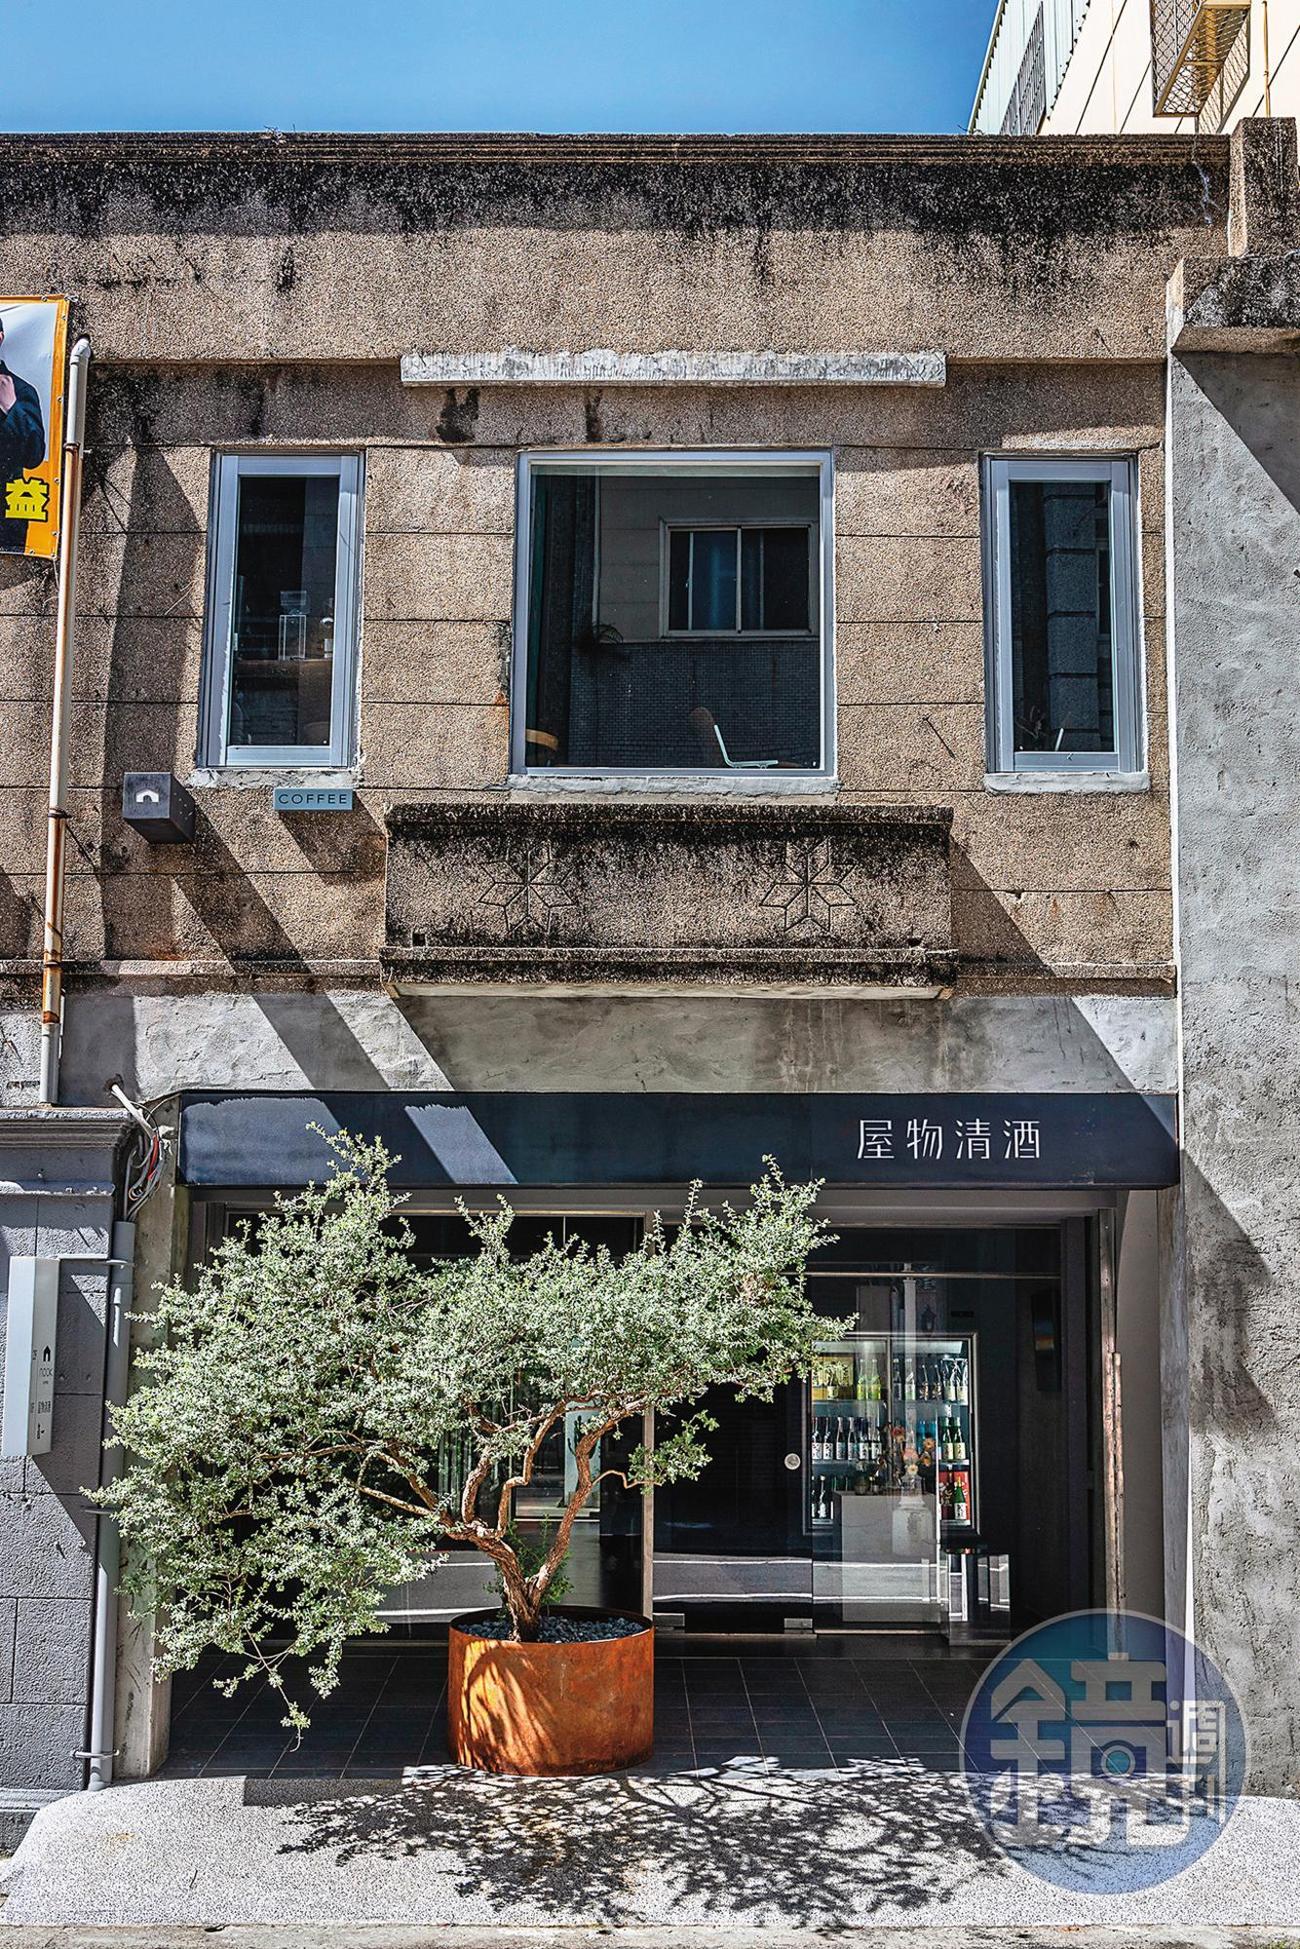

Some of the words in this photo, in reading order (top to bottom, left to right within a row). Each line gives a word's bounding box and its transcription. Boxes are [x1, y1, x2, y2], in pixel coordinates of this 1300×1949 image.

[5, 478, 48, 521] 益
[278, 793, 347, 805] COFFEE
[857, 1118, 1041, 1160] 屋物清酒
